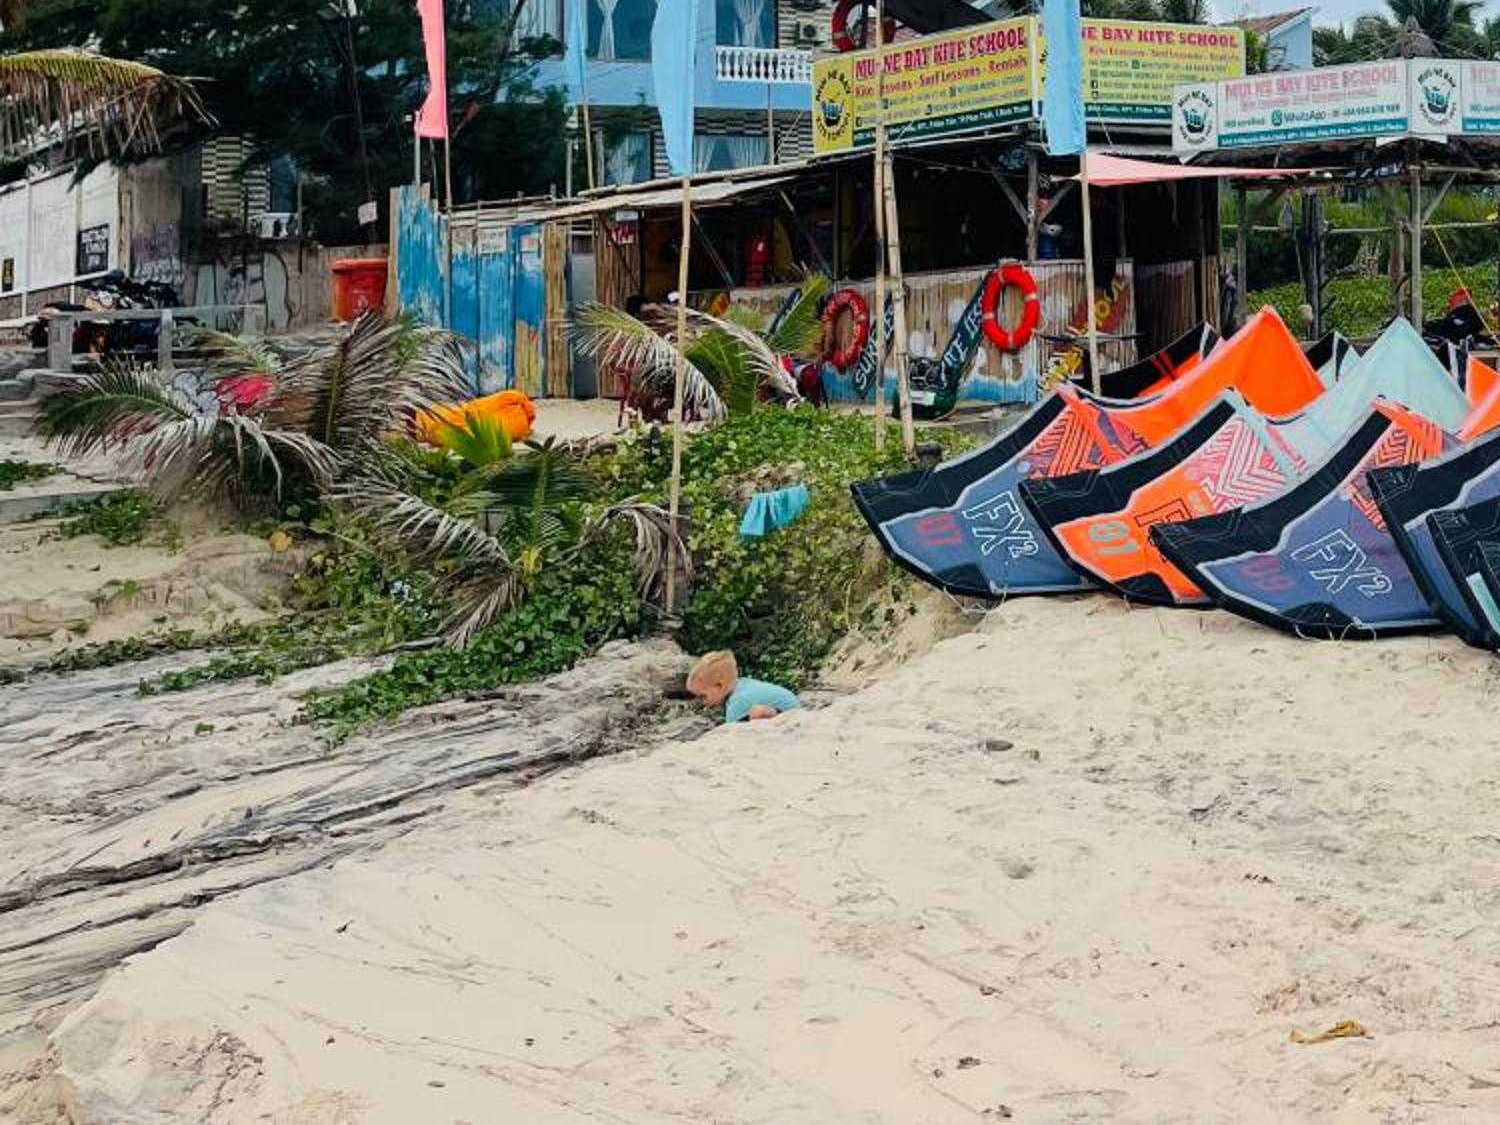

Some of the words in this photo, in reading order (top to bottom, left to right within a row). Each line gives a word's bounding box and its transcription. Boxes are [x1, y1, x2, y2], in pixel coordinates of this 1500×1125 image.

[1102, 27, 1134, 41] BAY
[1138, 28, 1174, 43] KITE
[1179, 31, 1239, 48] SCHOOL
[855, 56, 880, 79] MU
[904, 47, 930, 71] BAY
[933, 40, 966, 63] KITE
[969, 26, 1025, 57] SCHOOL
[1342, 65, 1398, 87] SCHOOL
[1283, 111, 1327, 125] WhatsApp
